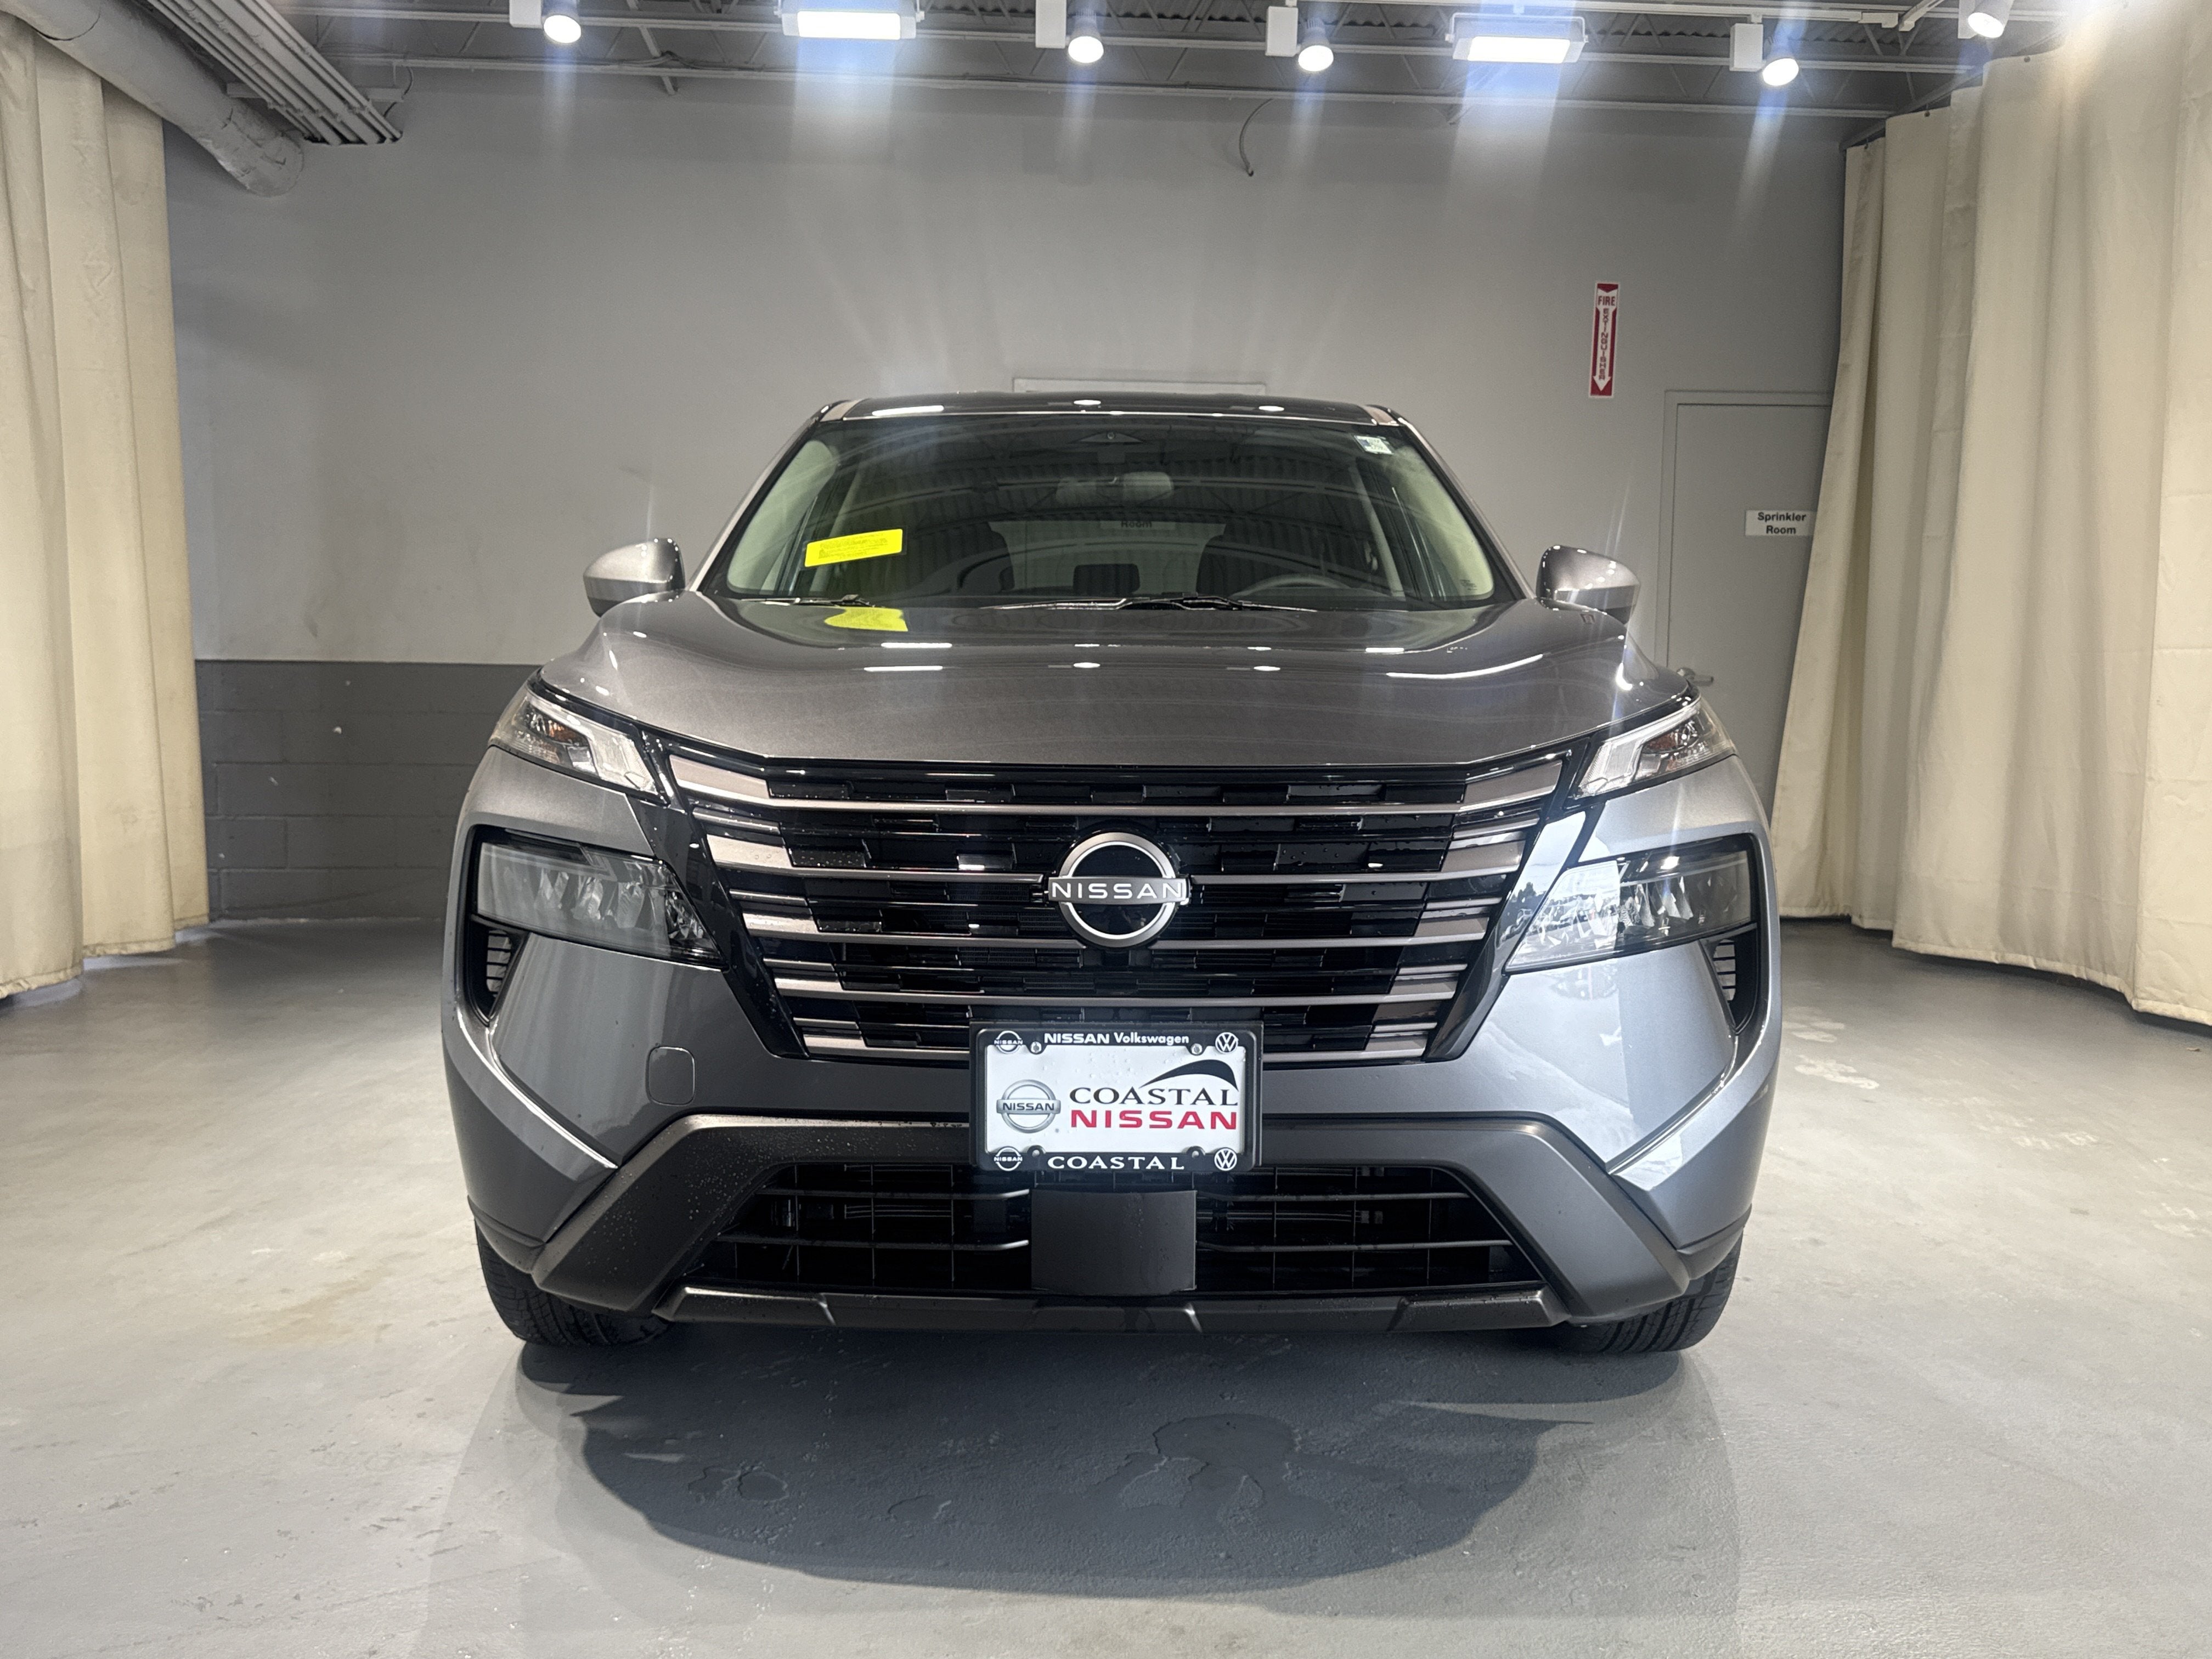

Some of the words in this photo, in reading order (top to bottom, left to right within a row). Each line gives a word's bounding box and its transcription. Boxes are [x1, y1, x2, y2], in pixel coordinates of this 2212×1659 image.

[1598, 296, 1616, 306] FIRE
[1599, 308, 1609, 380] EXTINGUISHER
[1758, 512, 1807, 522] Sprinkler
[1766, 525, 1797, 534] Room
[1052, 882, 1181, 899] NISSAN
[1044, 1032, 1110, 1044] NISSAN
[1114, 1032, 1189, 1046] Volkswagen
[1069, 1086, 1239, 1107] COASTAL
[1002, 1102, 1055, 1112] NISSAN
[1070, 1109, 1237, 1130] NISSAN
[1047, 1155, 1184, 1170] COASTAL
